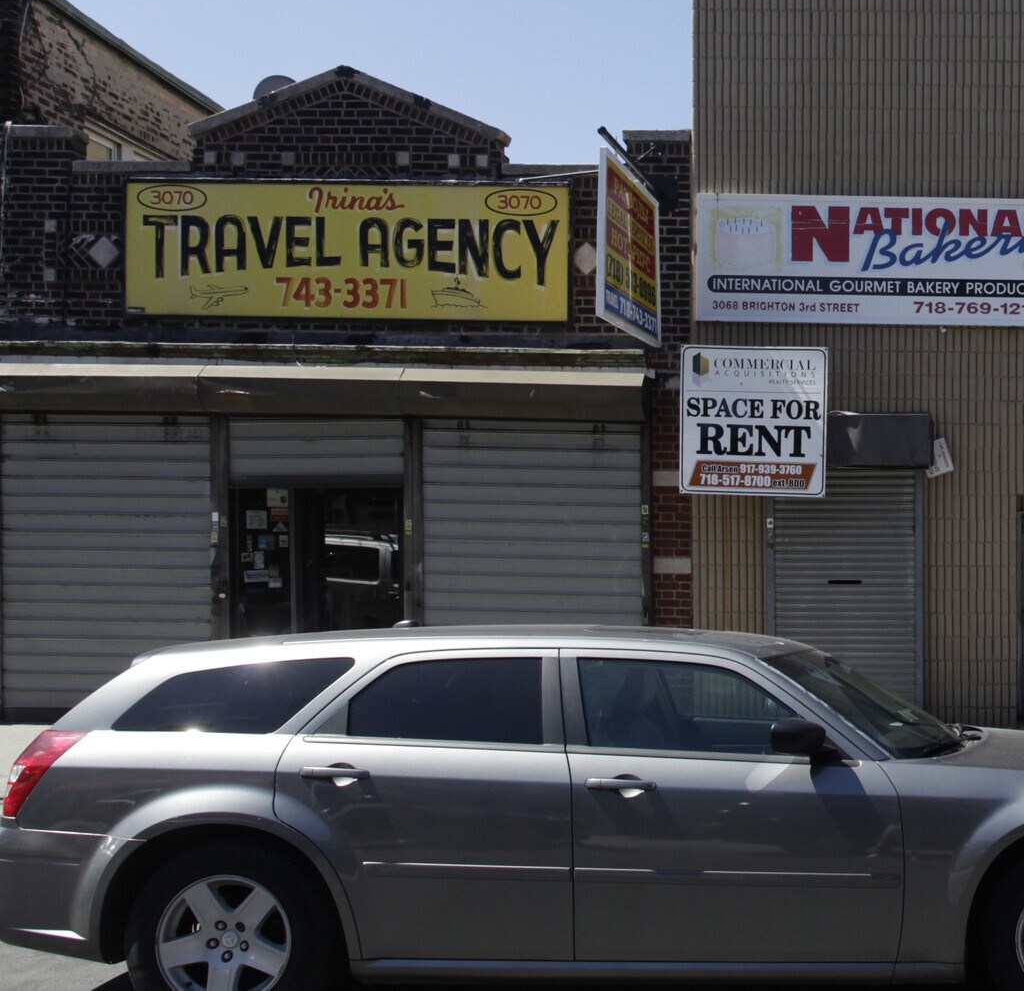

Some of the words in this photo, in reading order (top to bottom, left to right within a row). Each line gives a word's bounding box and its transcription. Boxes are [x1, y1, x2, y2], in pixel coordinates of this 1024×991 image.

[150, 190, 194, 206] 3070
[308, 186, 405, 213] Irina's
[497, 194, 543, 210] 3070
[142, 214, 342, 279] TRAVEL
[359, 216, 560, 286] AGENCY
[275, 276, 407, 309] 743-3371
[712, 278, 823, 293] INTERNATIONAL
[829, 280, 901, 294] GOURMET
[907, 281, 960, 295] BAKERY
[712, 300, 740, 311] 3068
[742, 301, 796, 312] BRIGHTON
[799, 301, 817, 312] 3rd
[819, 302, 860, 313] STREET
[713, 357, 817, 371] COMMERCIAL
[714, 370, 816, 379] ACQUISITIONS
[686, 397, 763, 419] SPACE
[770, 398, 821, 421] FOR
[696, 422, 812, 458] RENT
[701, 464, 717, 473] Call
[717, 465, 738, 473] Arsen
[740, 464, 803, 475] 917-939-3760
[700, 474, 771, 487] 718-517-8700
